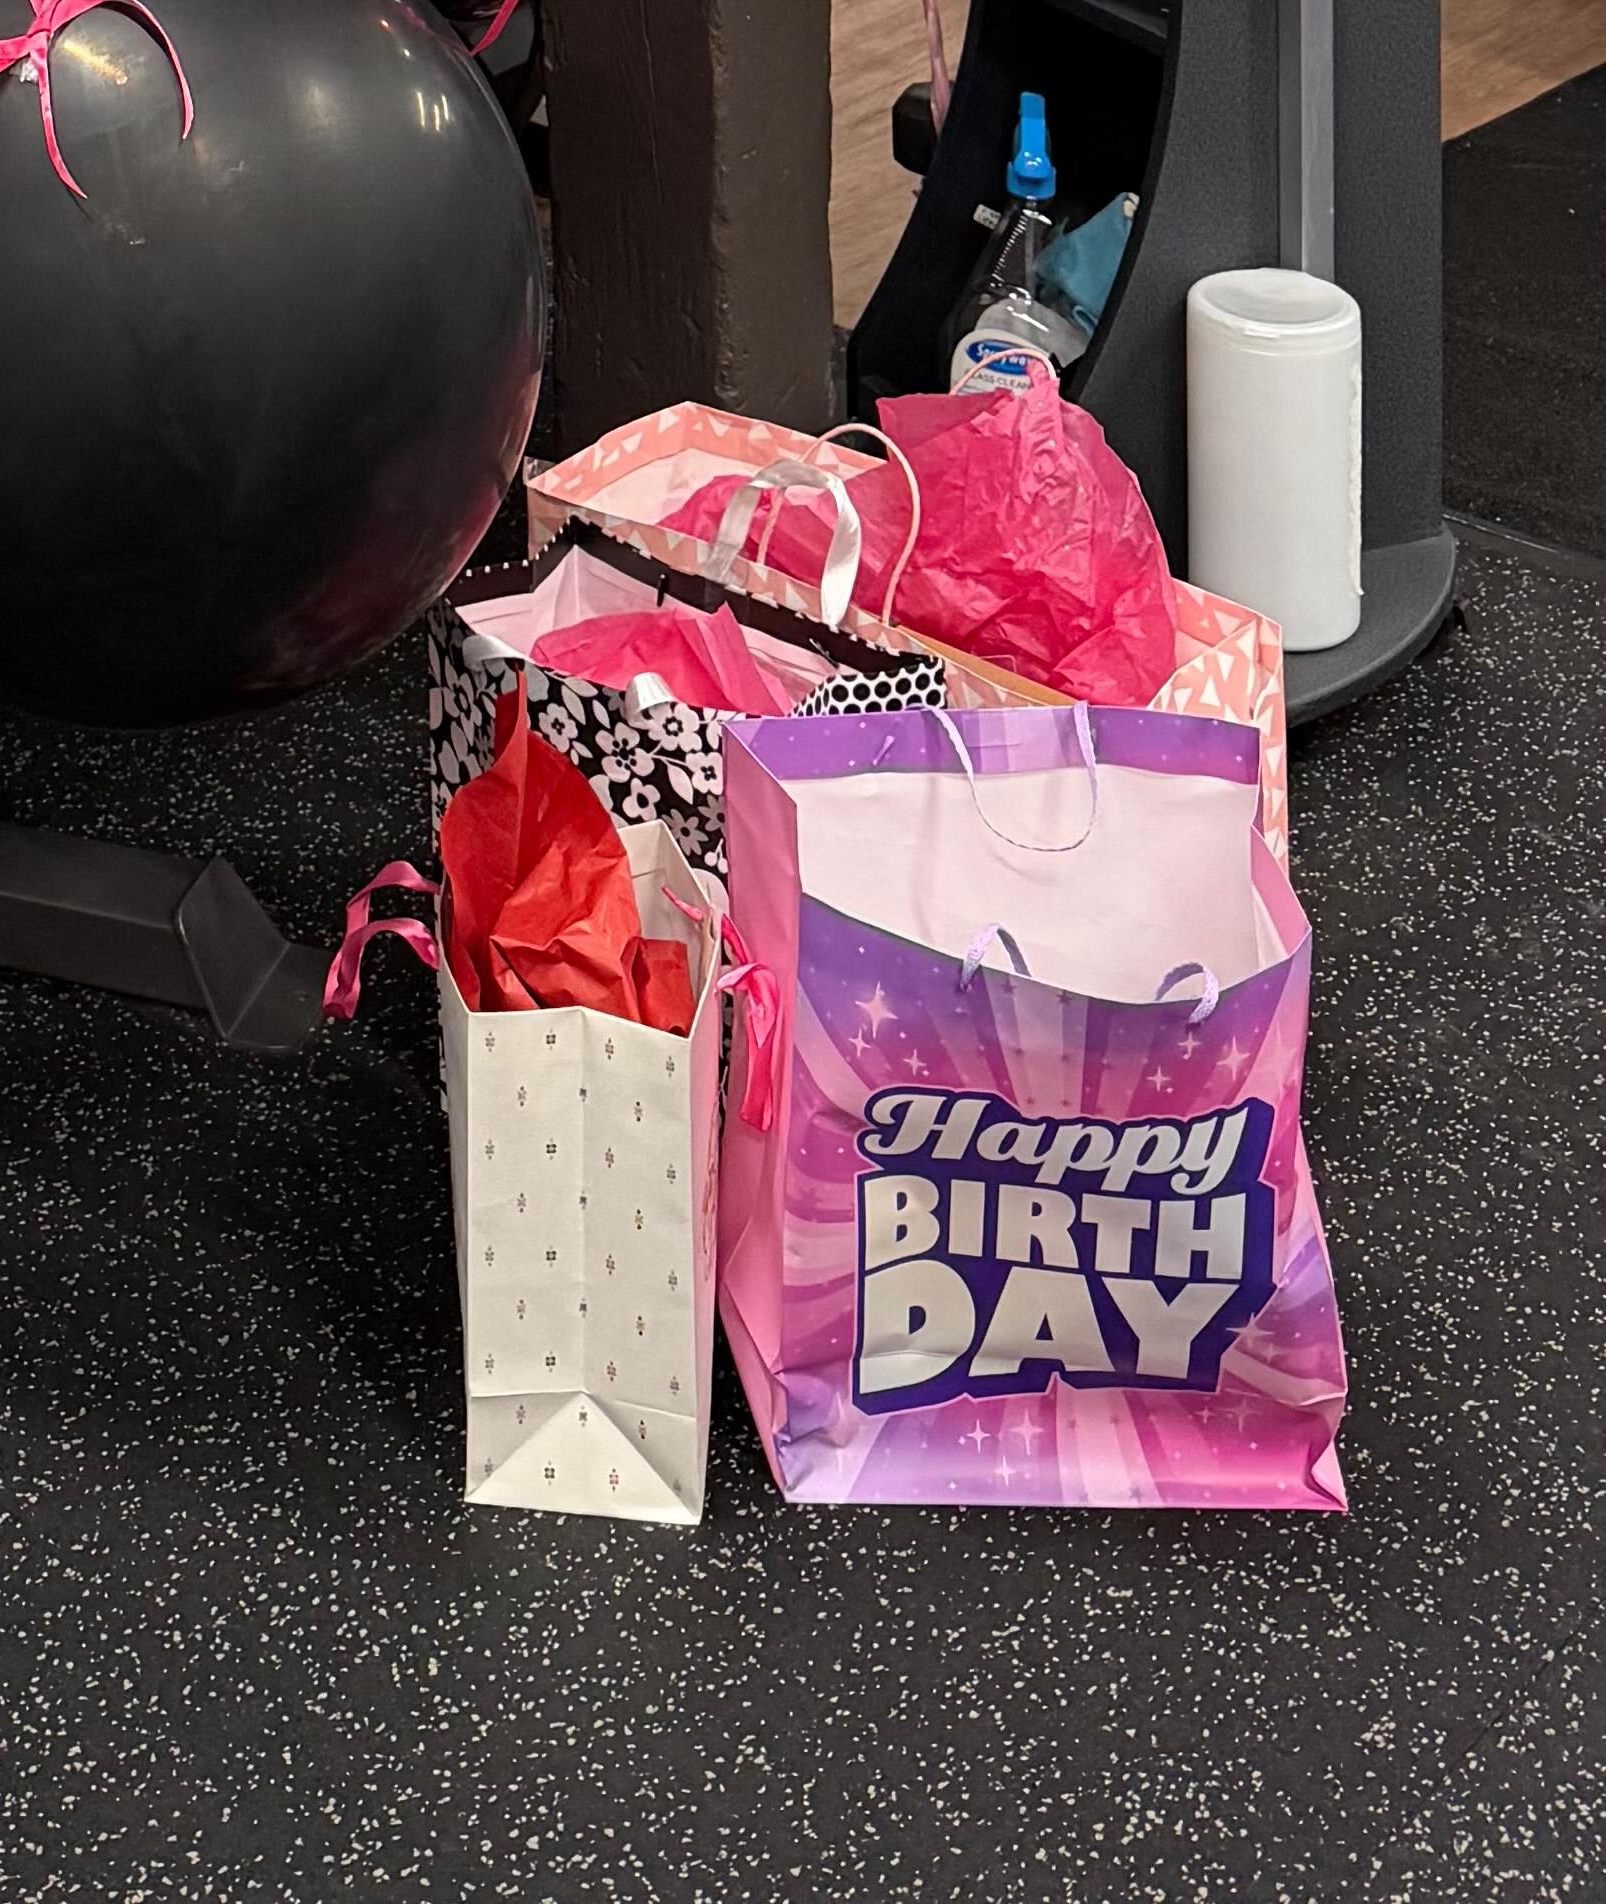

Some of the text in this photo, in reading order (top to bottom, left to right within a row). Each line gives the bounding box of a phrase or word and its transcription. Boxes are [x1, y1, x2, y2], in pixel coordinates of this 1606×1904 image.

[865, 1093, 1248, 1194] Happy
[864, 1174, 1247, 1282] BIRTH
[858, 1258, 1241, 1395] DAY
